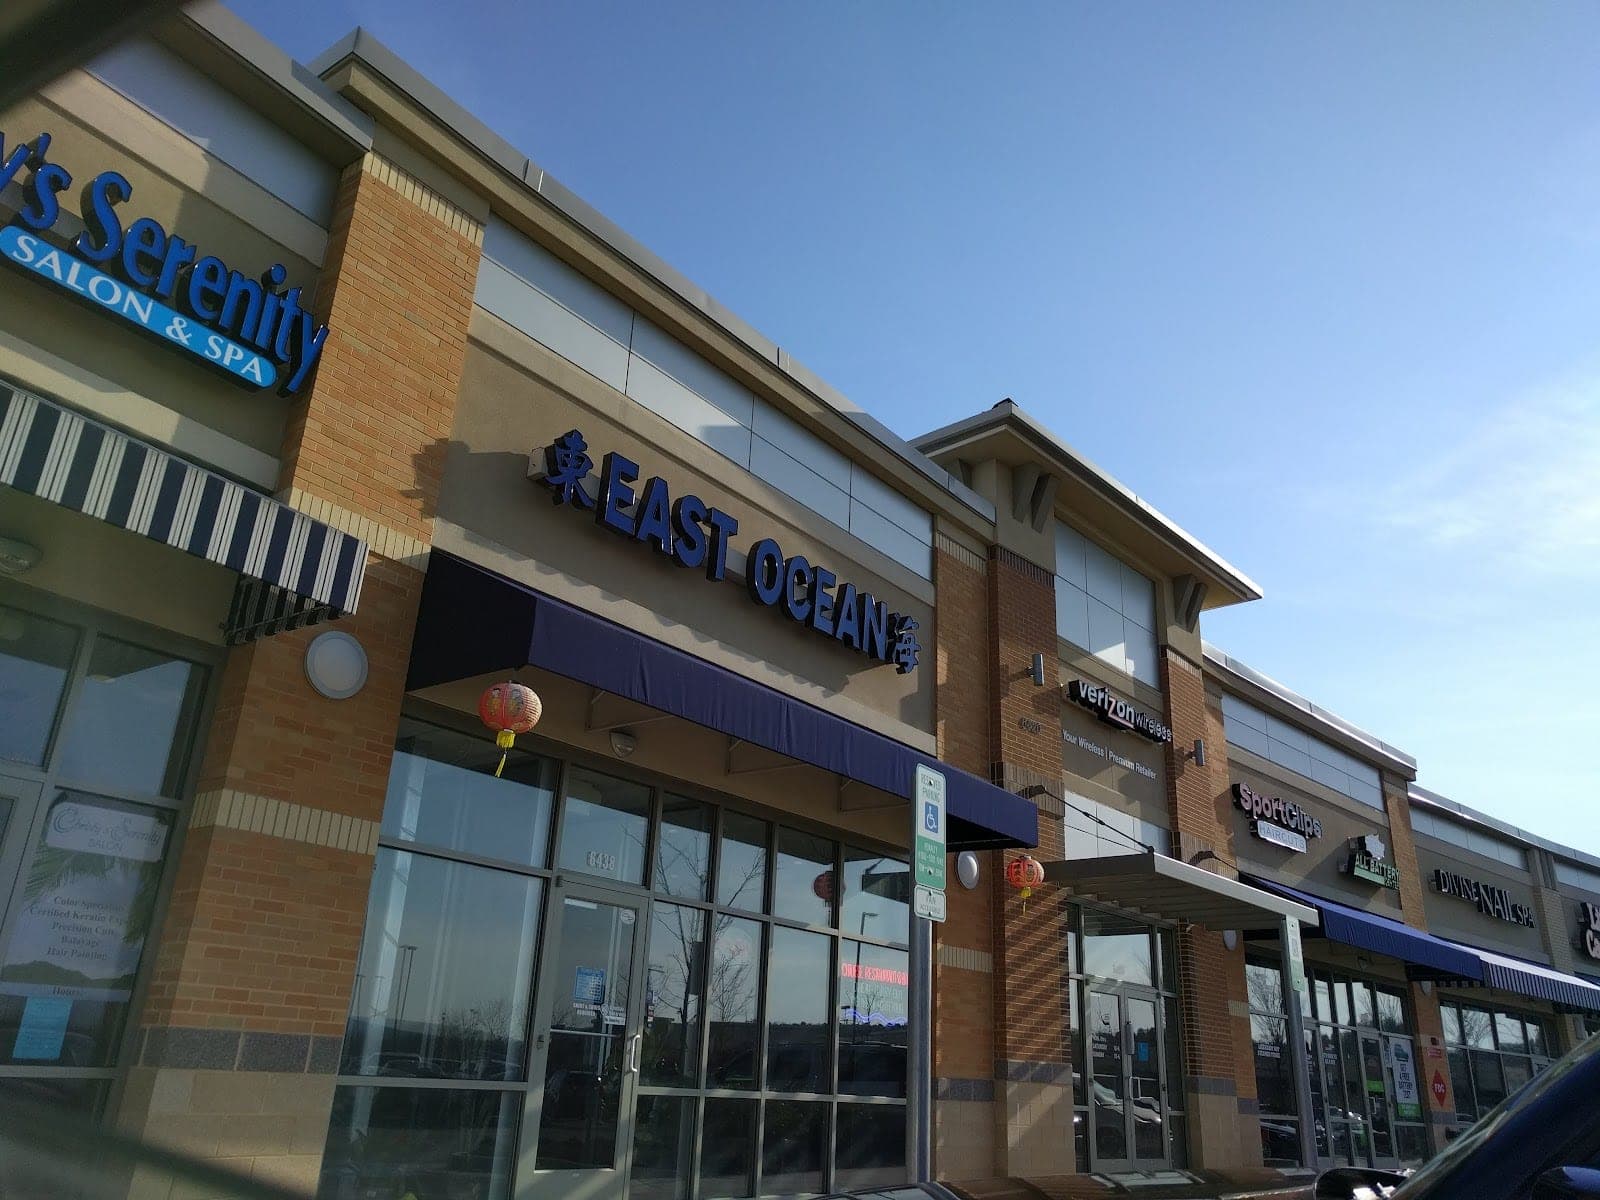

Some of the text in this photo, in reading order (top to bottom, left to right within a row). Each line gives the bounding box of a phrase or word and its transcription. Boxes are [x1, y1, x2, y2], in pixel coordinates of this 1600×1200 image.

[12, 235, 262, 383] SALON & SPA
[74, 171, 330, 395] Serenity
[599, 451, 890, 661] EAST OCEAN
[1077, 680, 1136, 729] verizon
[1134, 712, 1172, 743] wireless
[1062, 728, 1157, 780] Your Wireless Premium Retailer
[588, 851, 616, 871] 6438
[1479, 883, 1517, 923] NAIL
[1517, 904, 1535, 928] SPA
